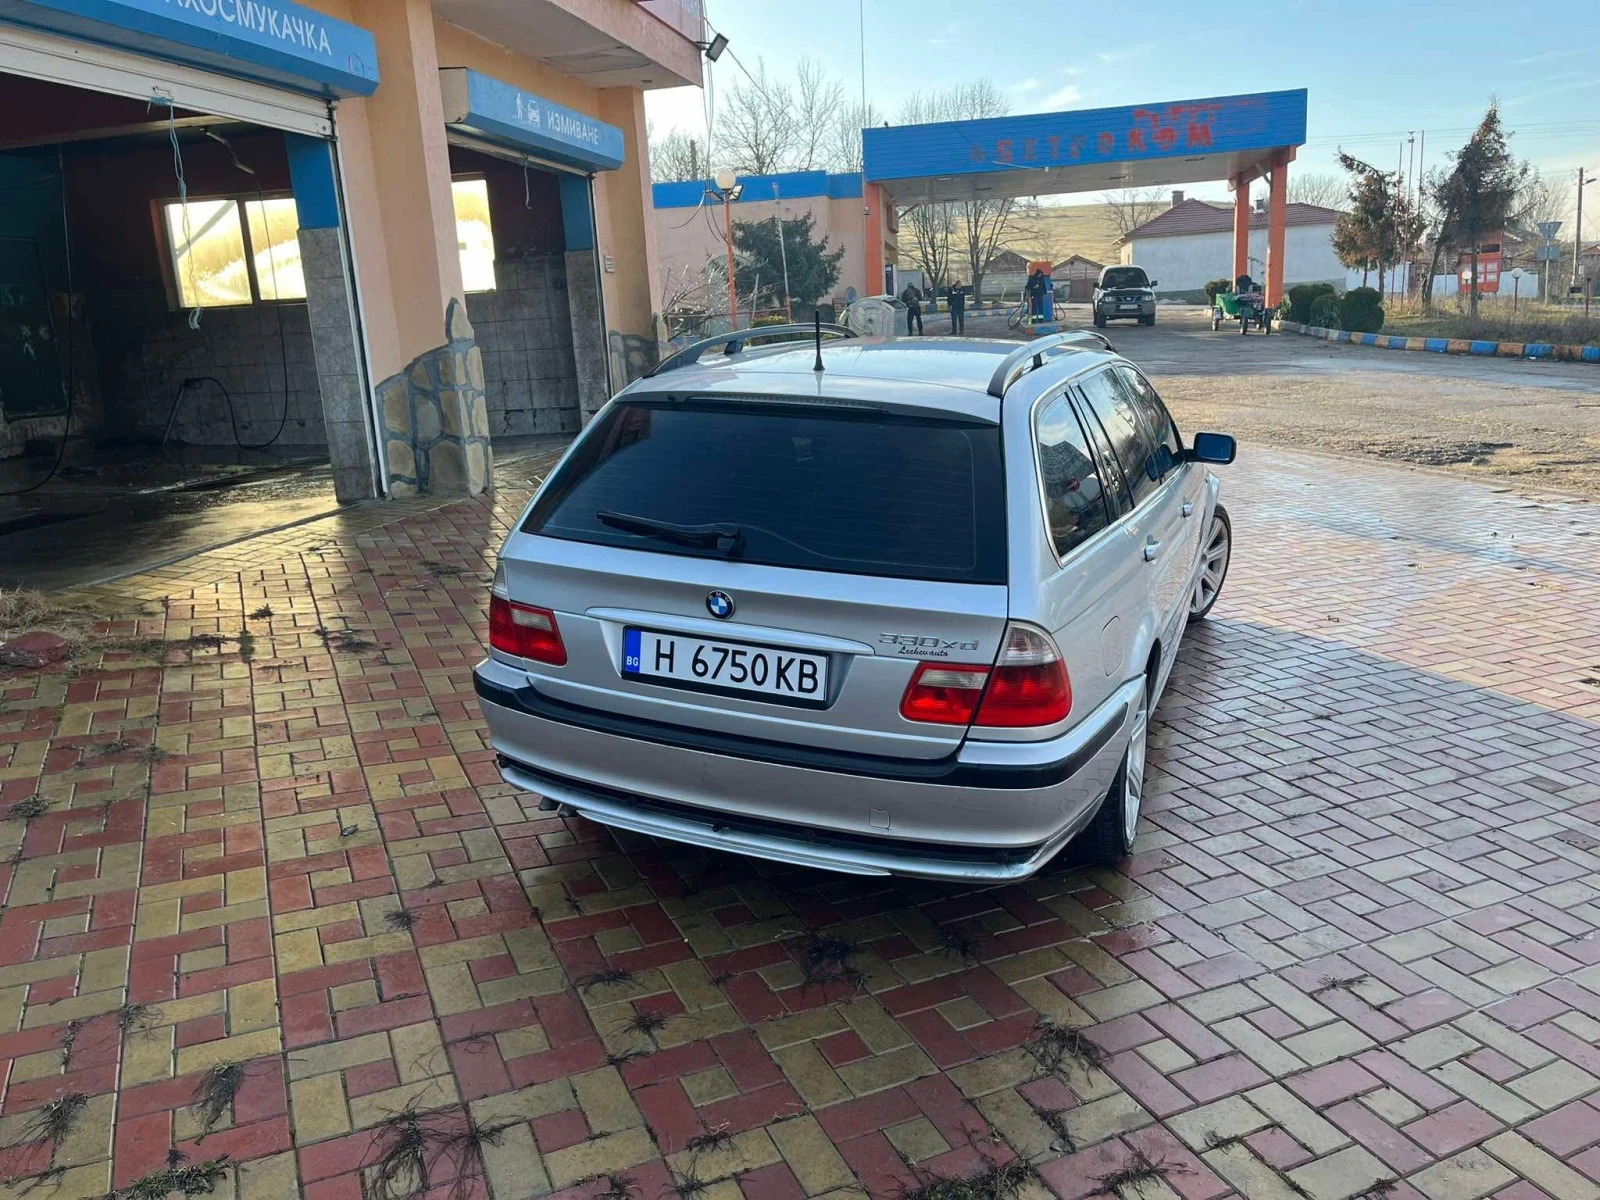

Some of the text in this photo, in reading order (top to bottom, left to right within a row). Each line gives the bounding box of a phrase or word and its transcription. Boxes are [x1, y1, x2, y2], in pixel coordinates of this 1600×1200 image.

[164, 0, 332, 56] ОСМУКАЧКА
[547, 110, 599, 145] ИЗМИВАНЕ
[626, 656, 639, 667] BG
[655, 638, 818, 694] H 6750 KB
